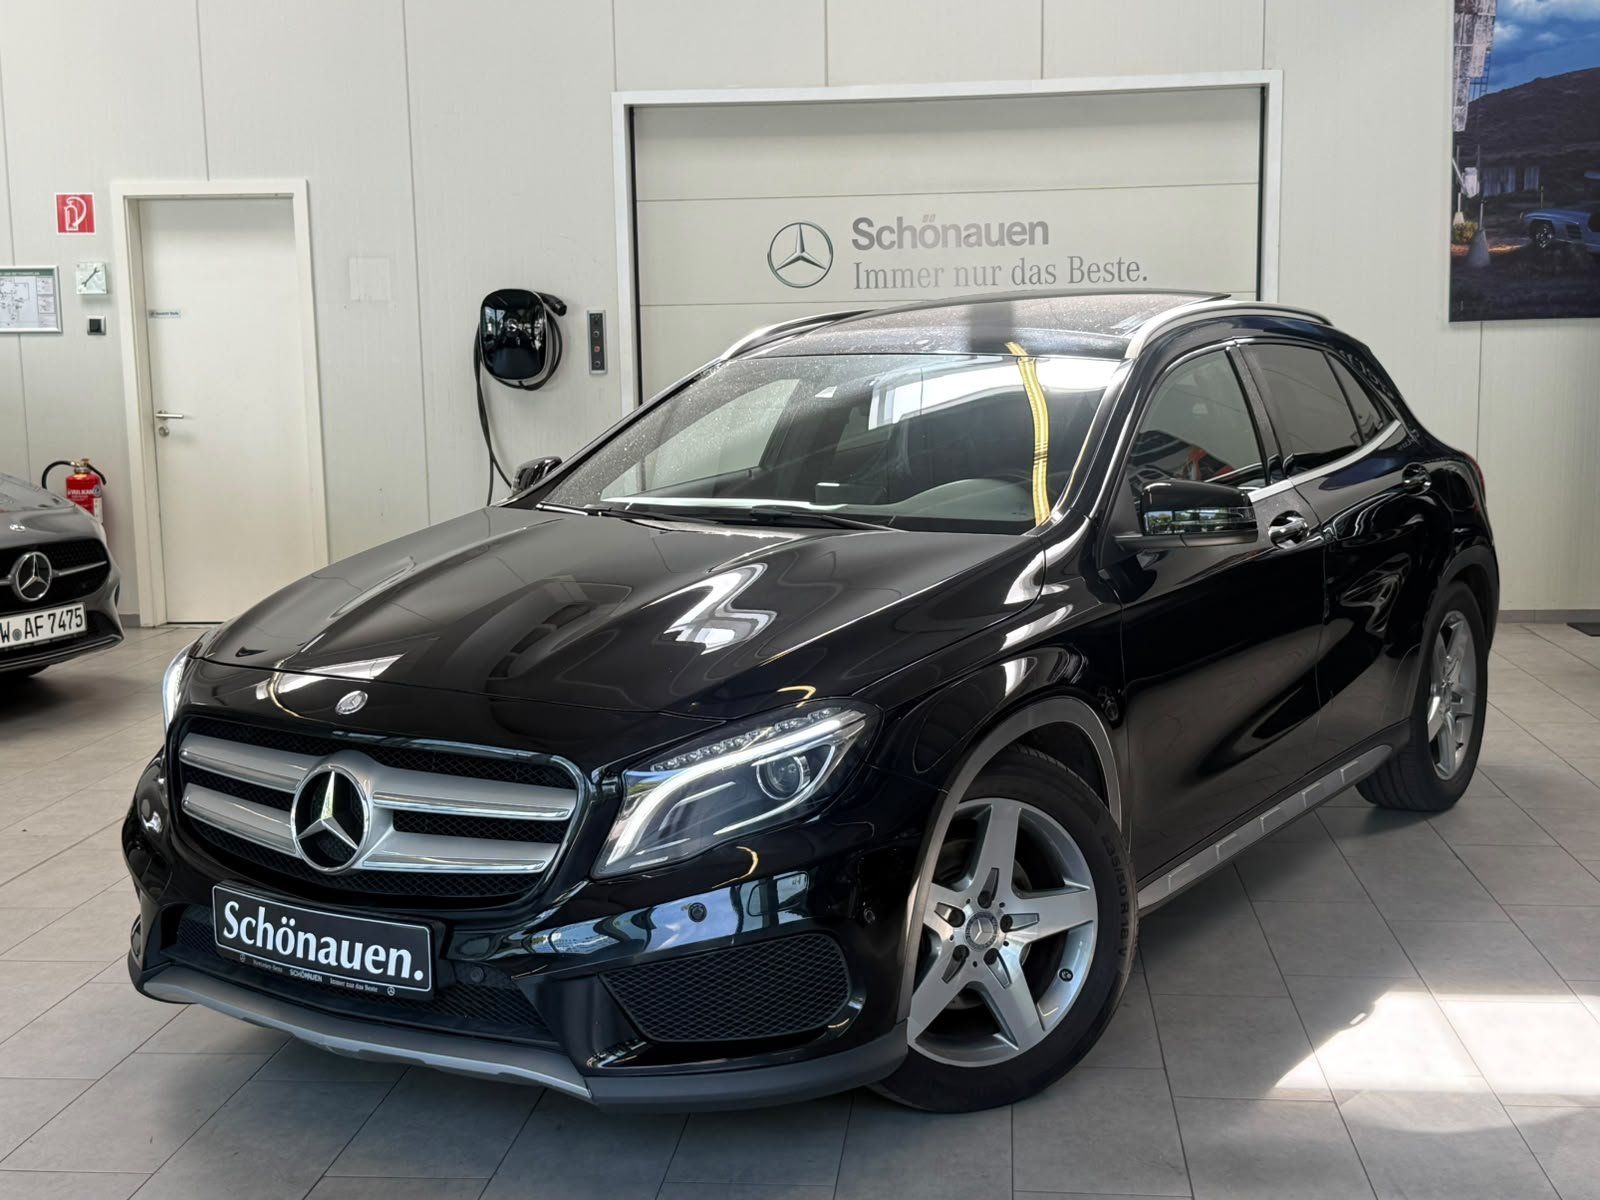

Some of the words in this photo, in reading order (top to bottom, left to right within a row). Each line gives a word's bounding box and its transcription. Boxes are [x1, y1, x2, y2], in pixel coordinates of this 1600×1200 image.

[852, 214, 1049, 251] Schönauen
[853, 262, 944, 289] Immer
[953, 262, 1002, 288] nur
[1011, 257, 1057, 286] das
[1067, 255, 1147, 284] Beste.
[25, 615, 44, 639] AF
[48, 607, 83, 634] 7475
[223, 901, 424, 981] Schönauen.
